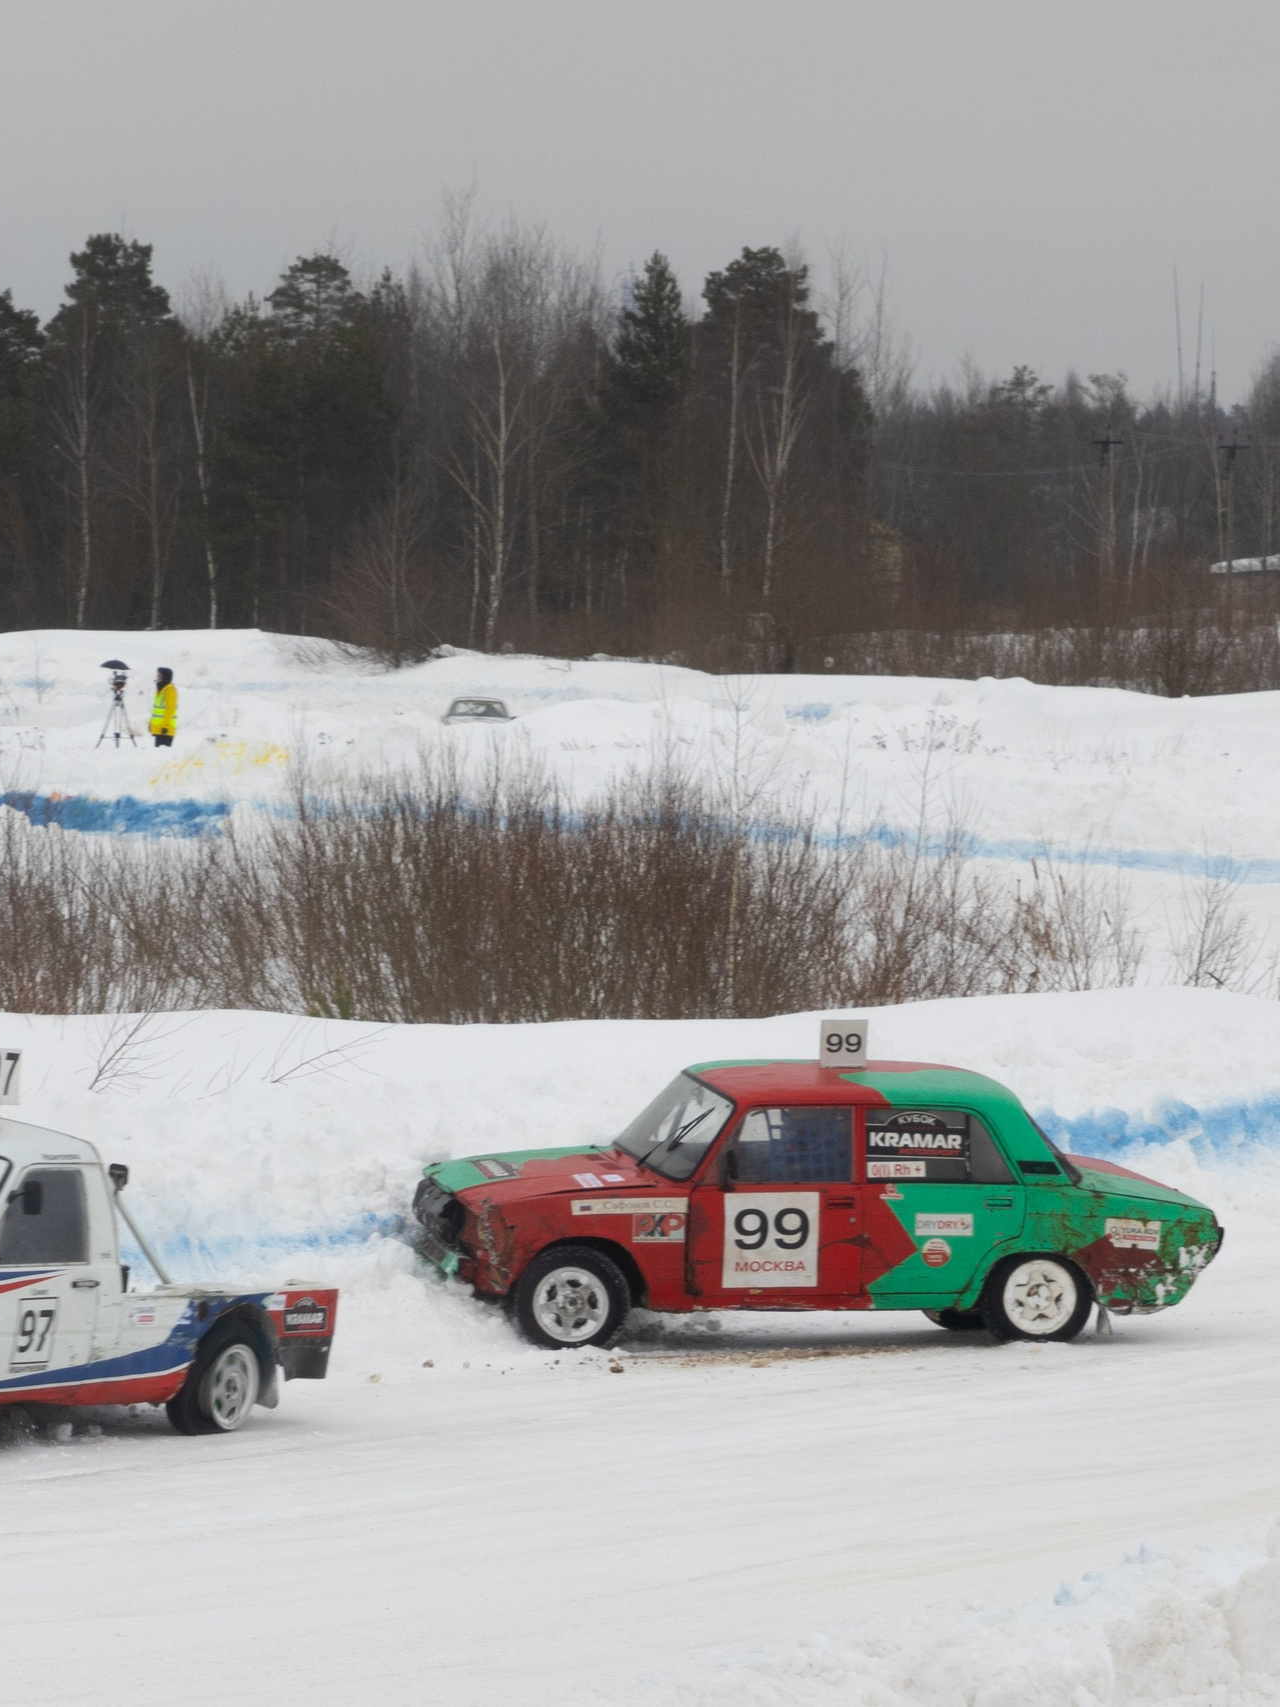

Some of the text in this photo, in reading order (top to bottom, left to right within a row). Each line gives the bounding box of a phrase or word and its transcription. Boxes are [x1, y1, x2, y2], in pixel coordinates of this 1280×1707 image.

[826, 1033, 862, 1053] 99
[897, 1114, 937, 1126] КУБОК
[869, 1132, 962, 1149] KRAMAR
[894, 1164, 911, 1176] Rh
[734, 1207, 810, 1250] 99
[735, 1261, 806, 1273] МОСКВА
[17, 1310, 55, 1353] 97
